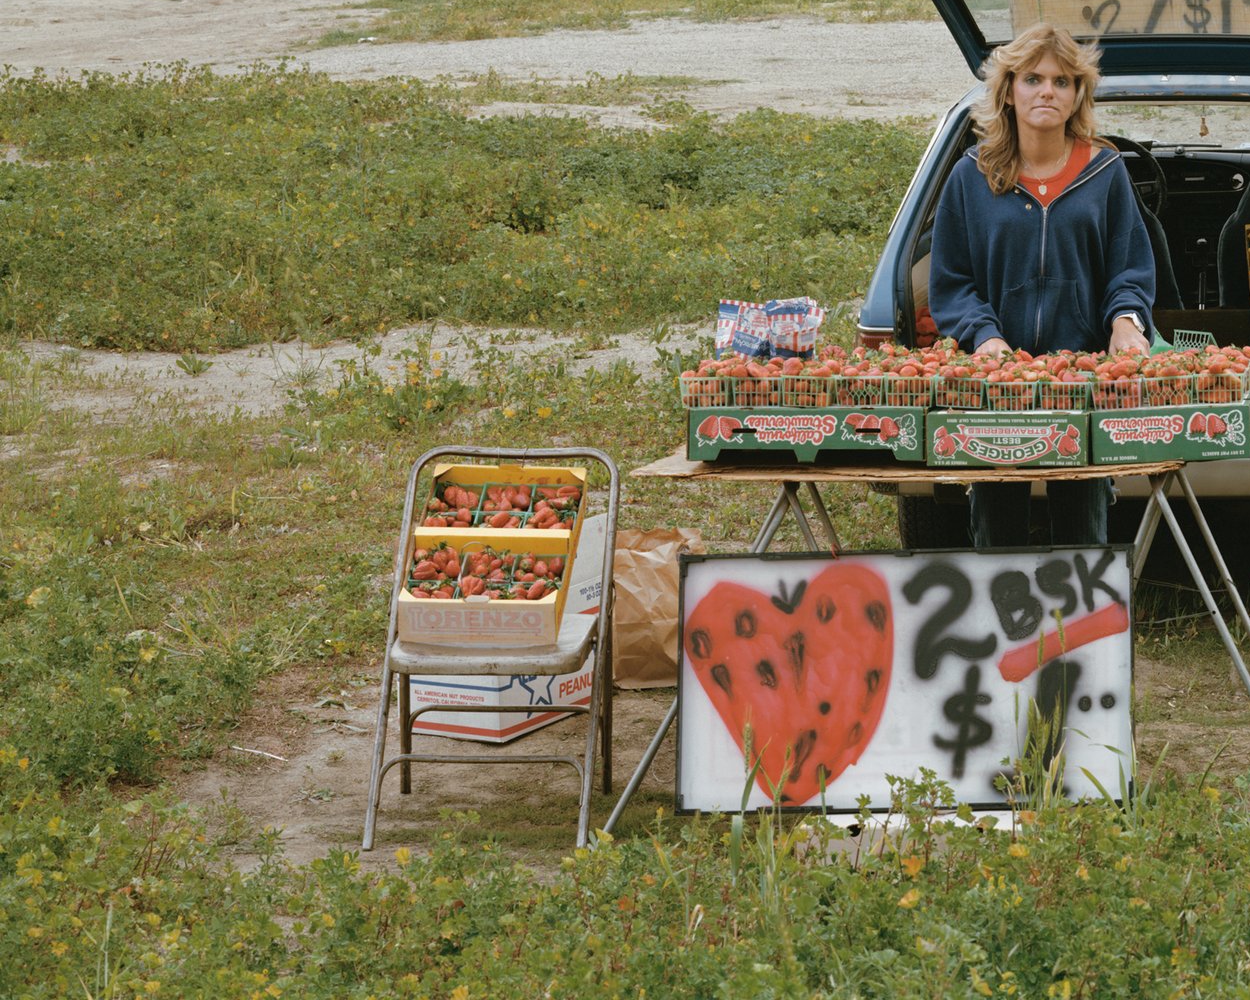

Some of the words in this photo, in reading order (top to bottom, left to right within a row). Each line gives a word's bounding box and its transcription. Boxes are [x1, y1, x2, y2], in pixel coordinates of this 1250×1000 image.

[747, 416, 835, 435] Strawberries
[966, 427, 1047, 435] STRAWBERRIES
[1101, 416, 1184, 432] Strawberries
[757, 427, 823, 444] California
[1112, 430, 1174, 444] California
[967, 438, 1048, 460] GEORGE'S
[408, 606, 543, 634] LORENZO
[902, 561, 998, 681] 2
[991, 550, 1126, 641] BSK
[424, 690, 449, 698] AMERICAN
[459, 694, 485, 702] PRODUCTS
